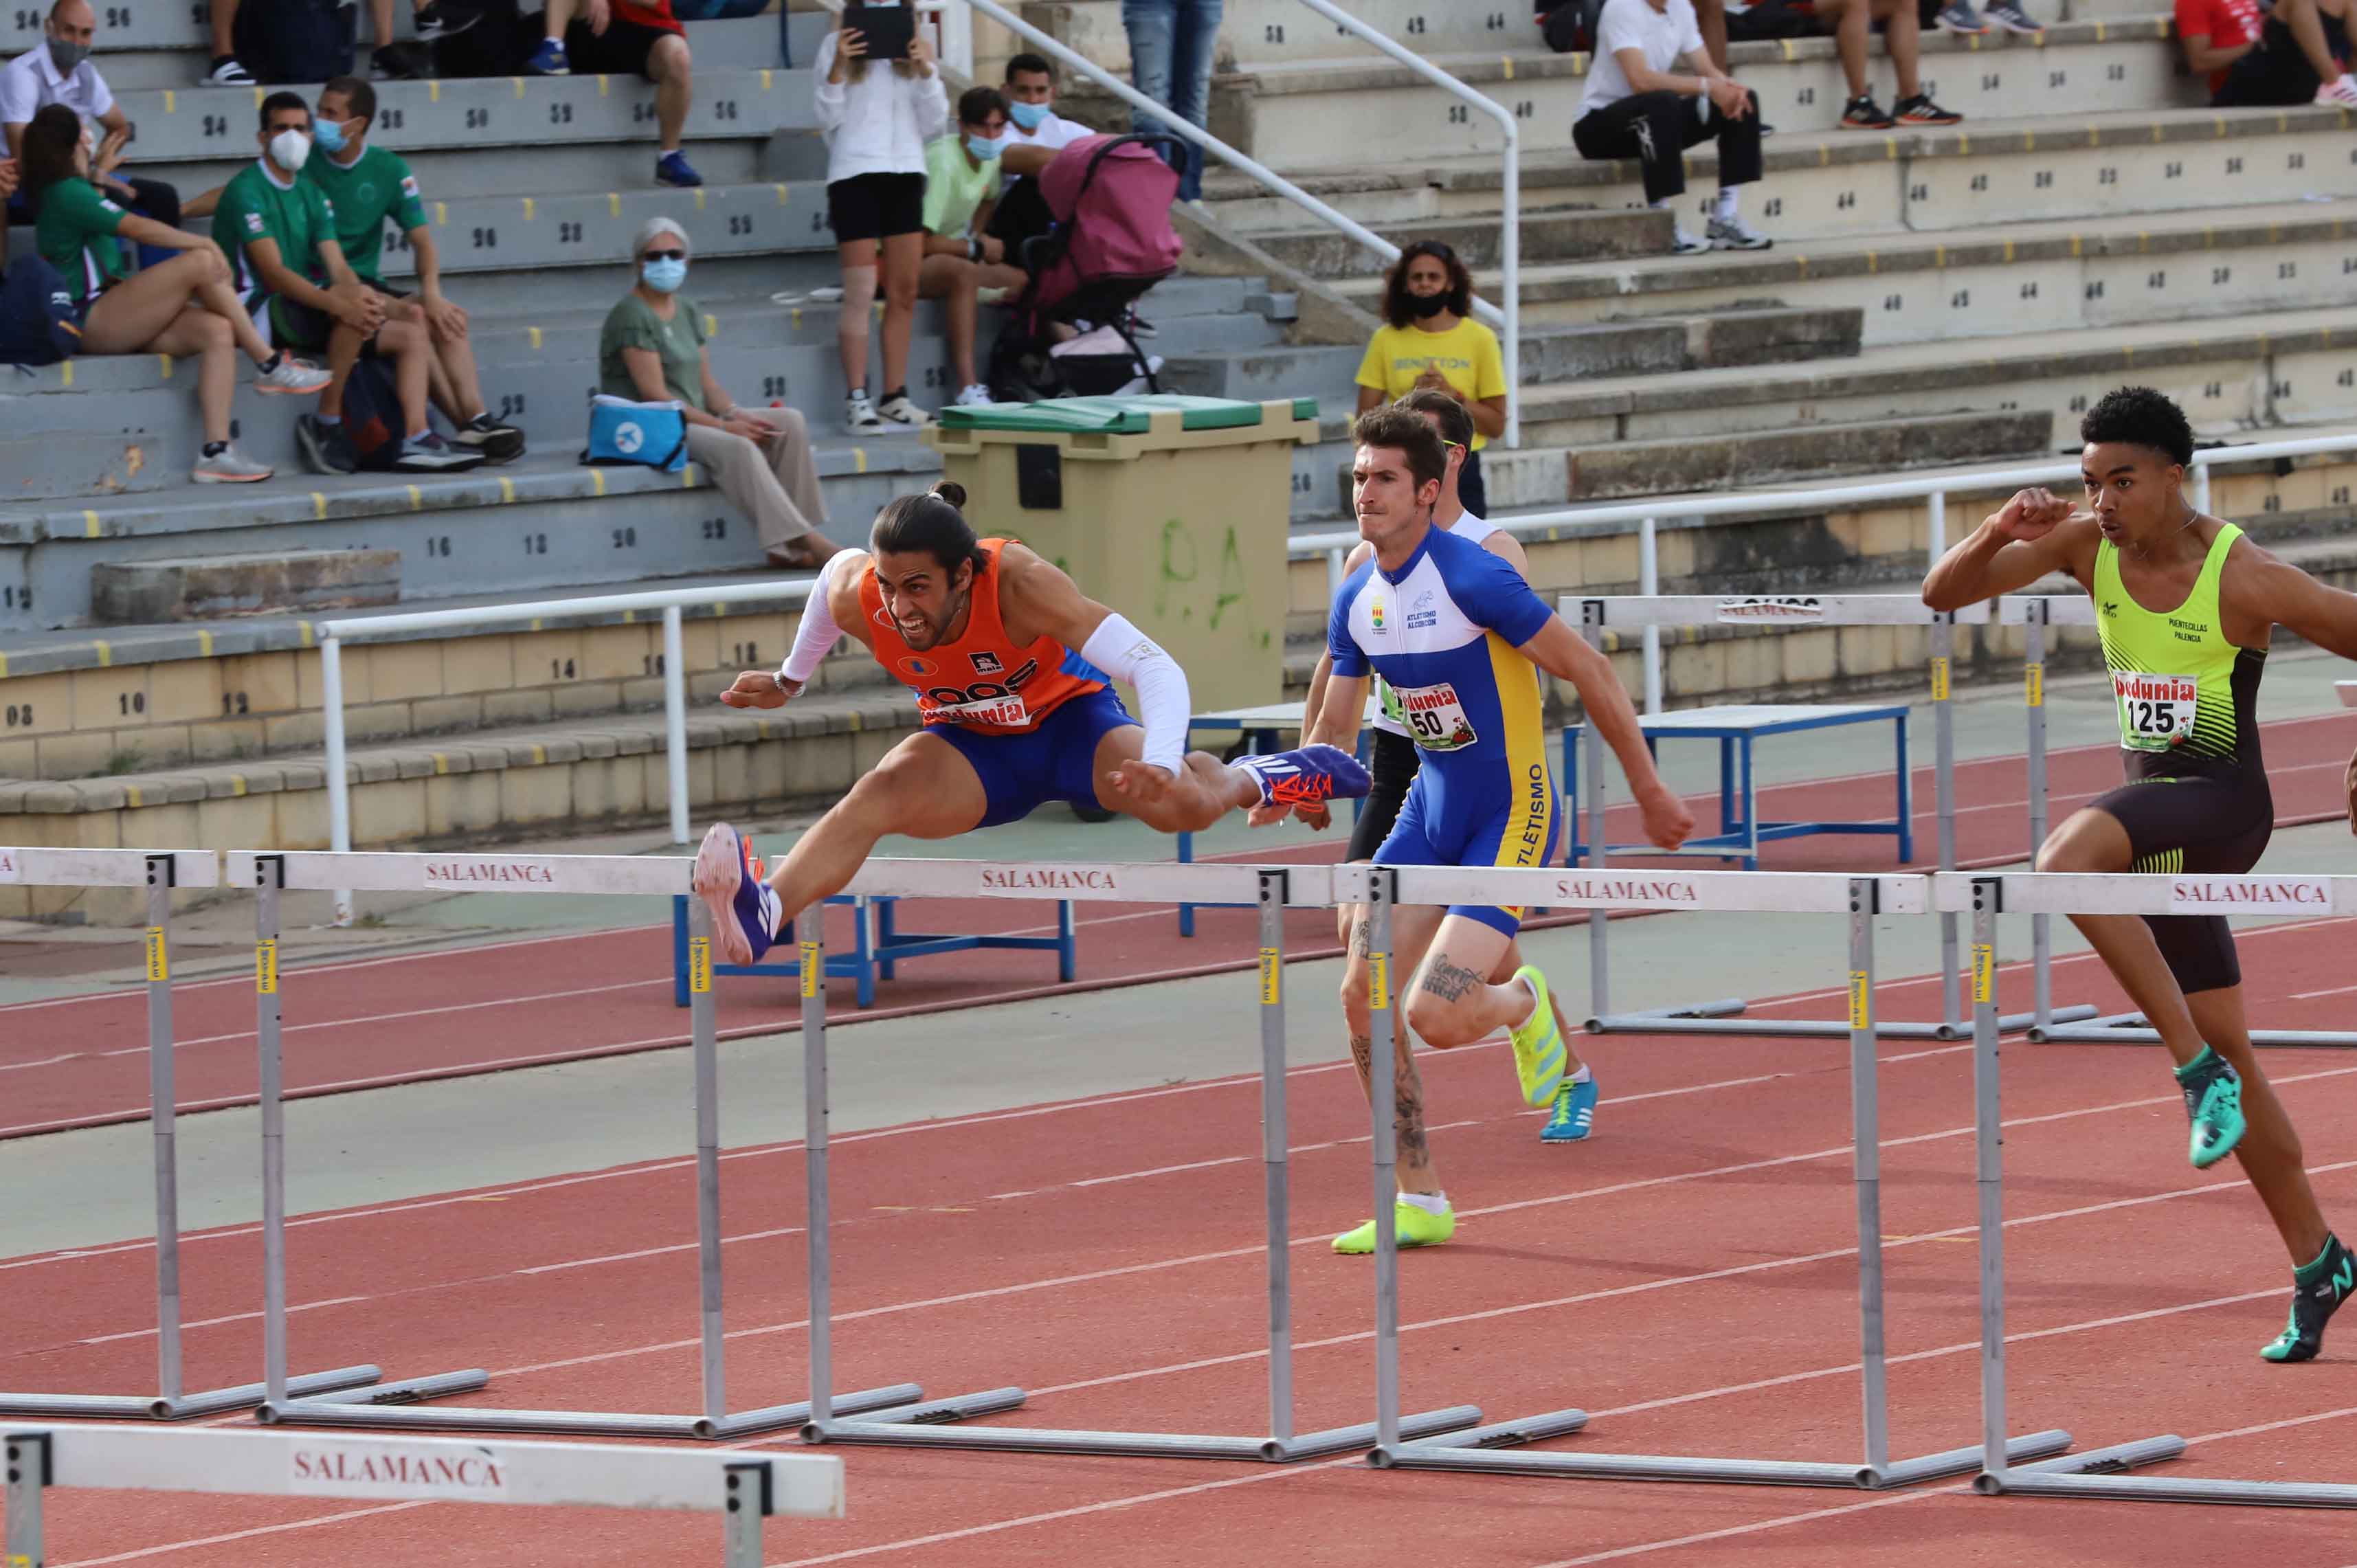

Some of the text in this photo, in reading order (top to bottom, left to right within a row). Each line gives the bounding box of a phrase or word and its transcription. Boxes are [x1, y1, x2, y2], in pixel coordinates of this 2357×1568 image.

[1407, 609, 1437, 621] ATLETISMO
[2169, 618, 2208, 633] PUENTECILLAS
[2174, 631, 2202, 643] PALENCIA
[552, 658, 575, 679] 14
[2114, 675, 2195, 702] bedunia
[120, 692, 145, 715] 10
[1409, 711, 1443, 736] 50
[2127, 701, 2175, 733] 125
[1517, 763, 1545, 865] TLETISMO
[426, 863, 553, 883] SALAMANCA
[981, 869, 1117, 890] SALAMANCA
[1556, 880, 1696, 901] SALAMANCA
[2173, 884, 2328, 904] SALAMANCA
[293, 1451, 504, 1488] SALAMANCA
